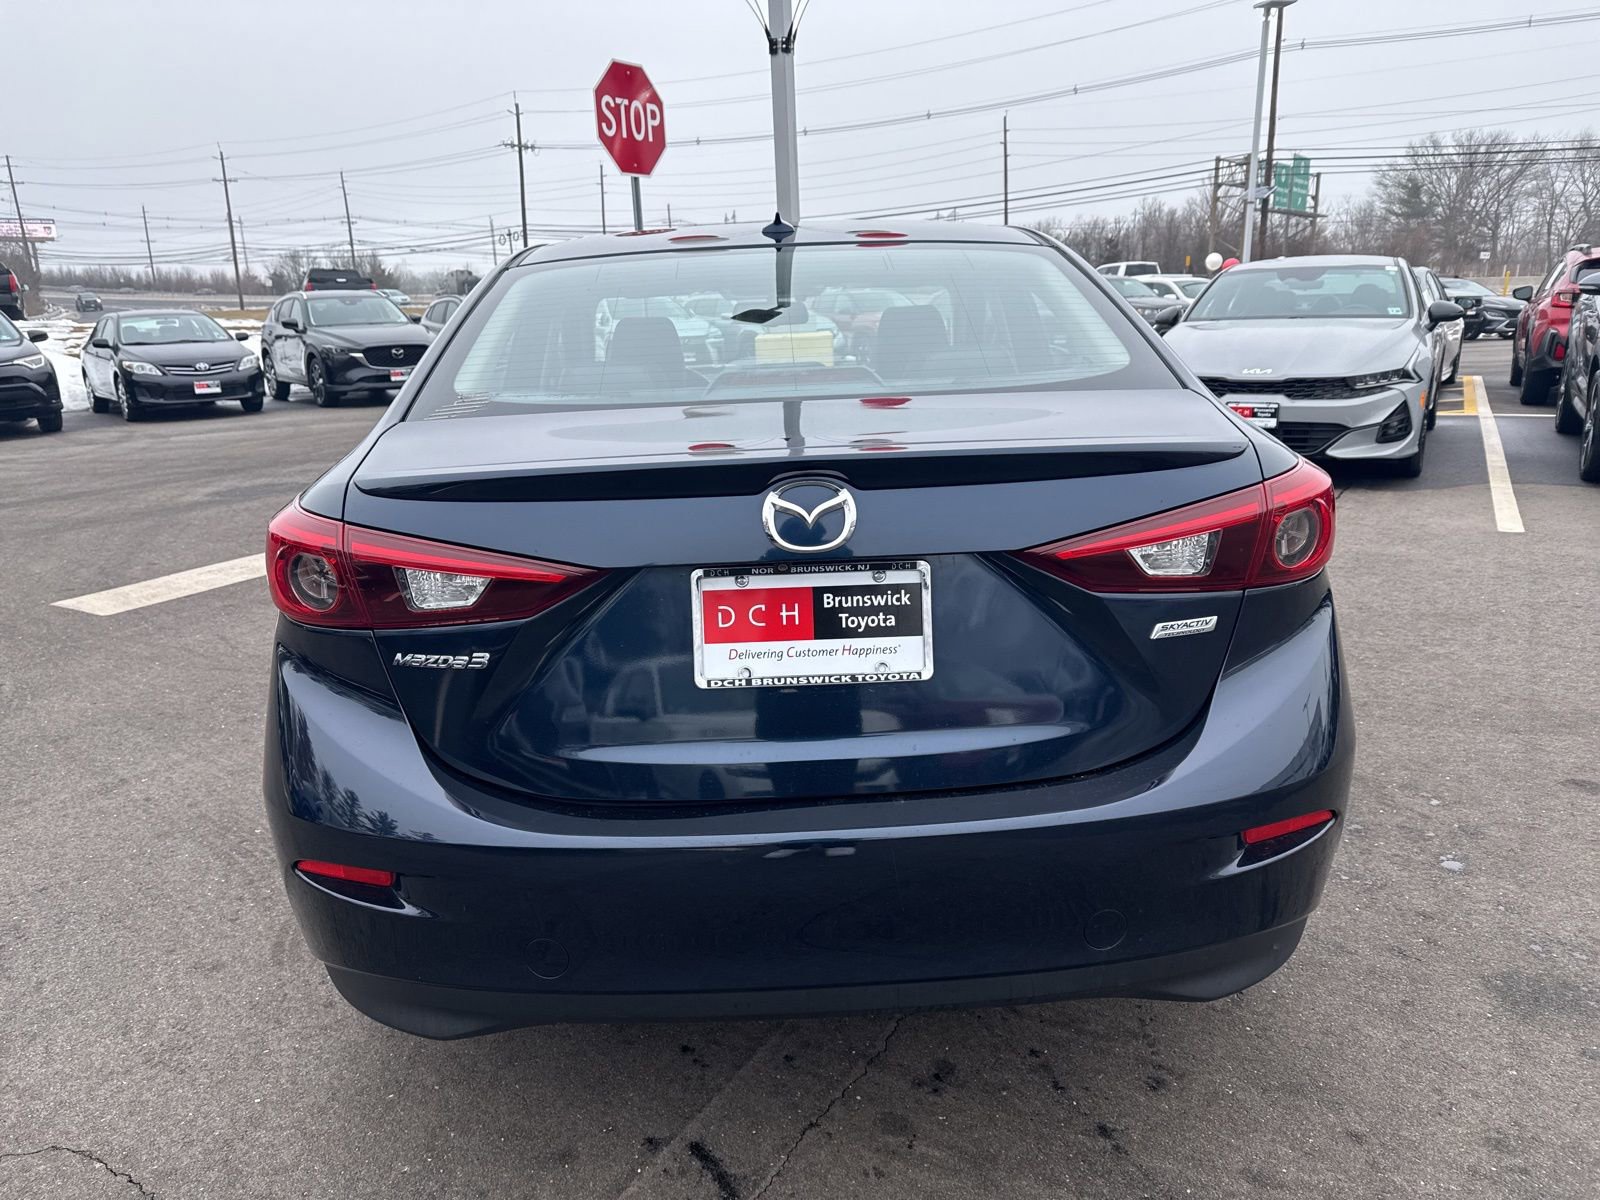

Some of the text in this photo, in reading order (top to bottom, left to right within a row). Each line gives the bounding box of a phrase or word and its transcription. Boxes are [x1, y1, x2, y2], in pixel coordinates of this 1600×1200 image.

[601, 94, 660, 142] STOP
[823, 589, 911, 608] Brunswick
[838, 612, 896, 632] Toyota
[1160, 618, 1213, 632] SKYACTIV
[728, 648, 784, 661] Delivering
[786, 646, 839, 657] Customer
[751, 675, 851, 686] BRUNSWICK
[855, 672, 920, 681] TOYOTA
